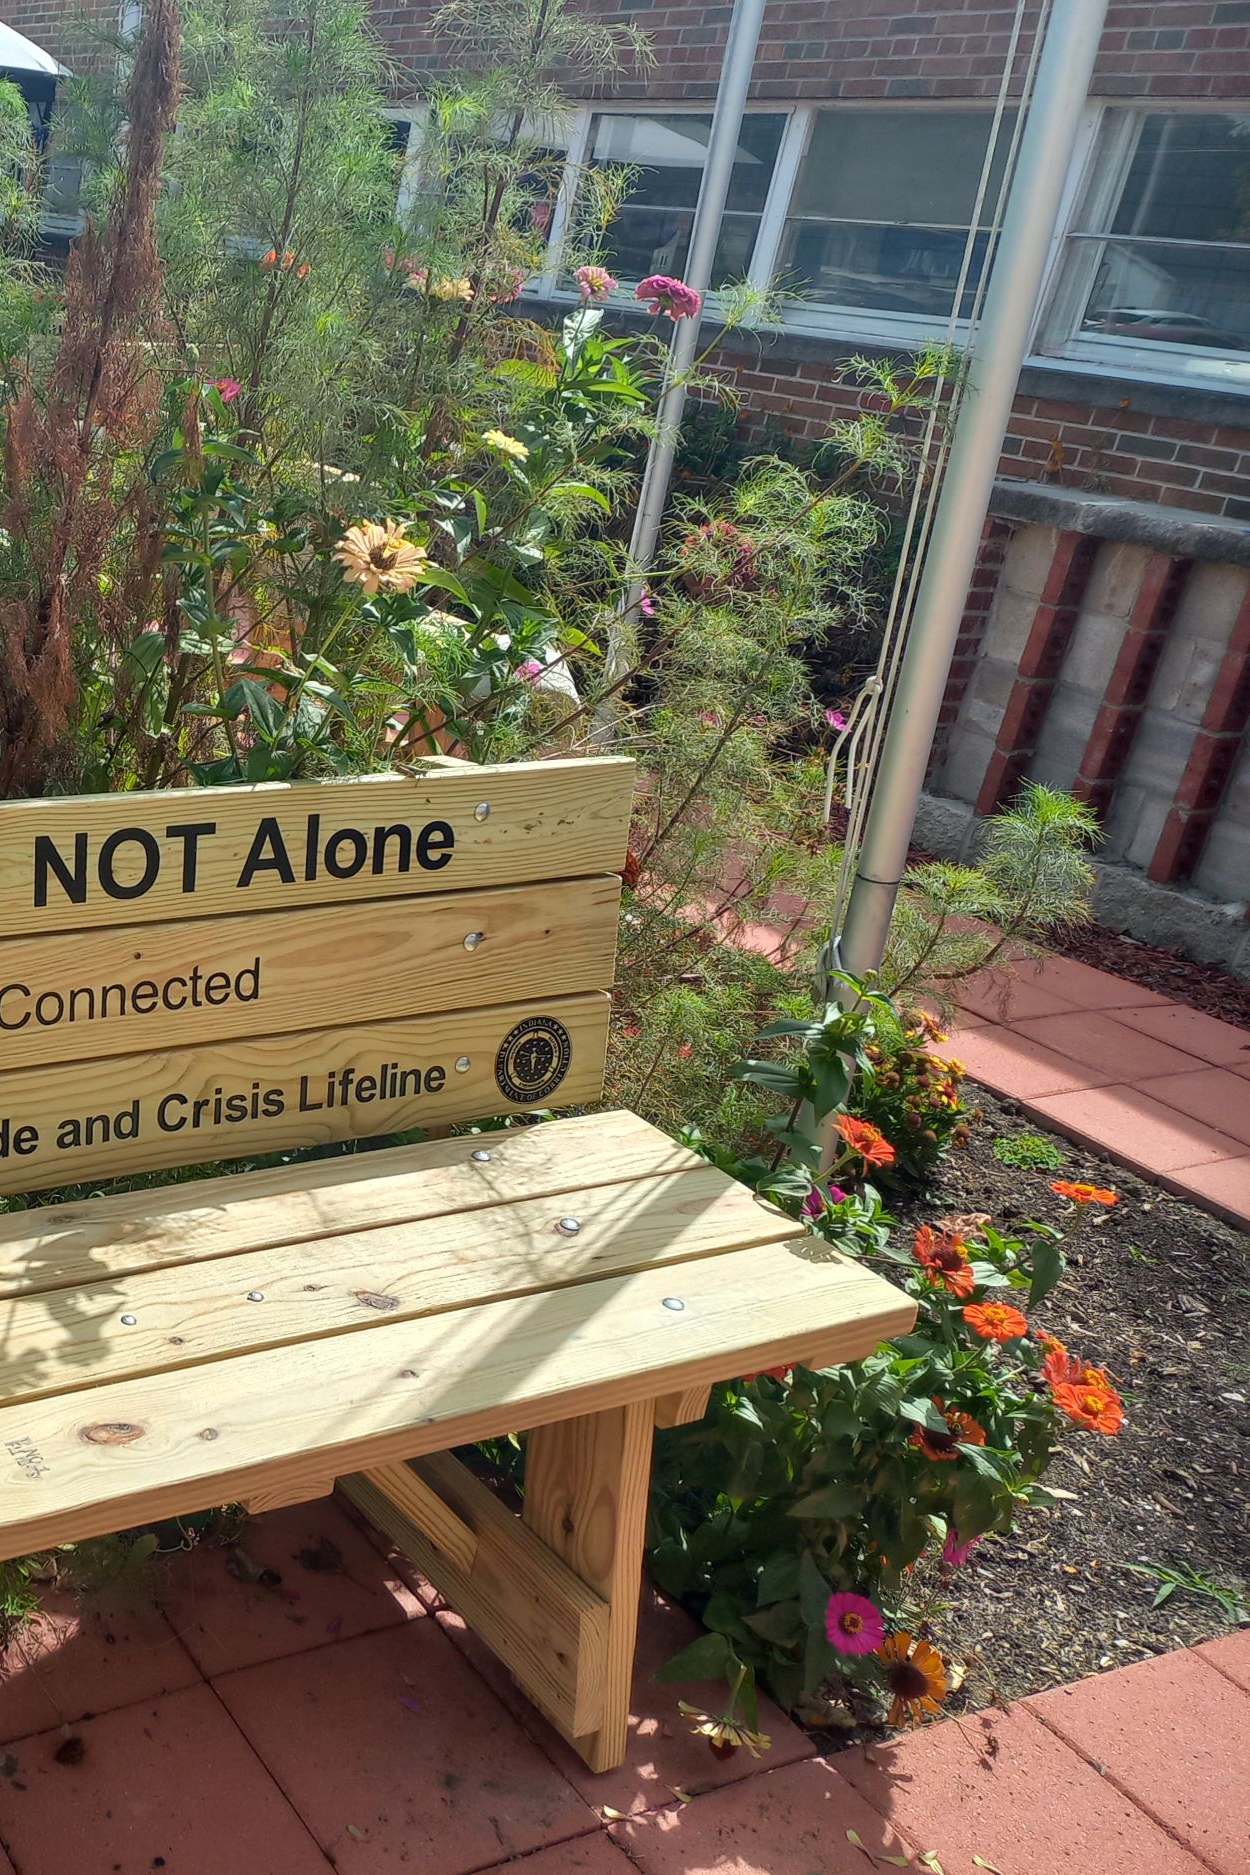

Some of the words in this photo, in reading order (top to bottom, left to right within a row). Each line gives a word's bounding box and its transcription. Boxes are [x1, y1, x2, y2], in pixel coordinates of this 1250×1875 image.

[34, 823, 217, 907] NOT
[237, 814, 455, 888] Alone
[56, 1100, 140, 1149] and
[157, 1083, 285, 1132] Crisis
[299, 1063, 446, 1113] Lifeline
